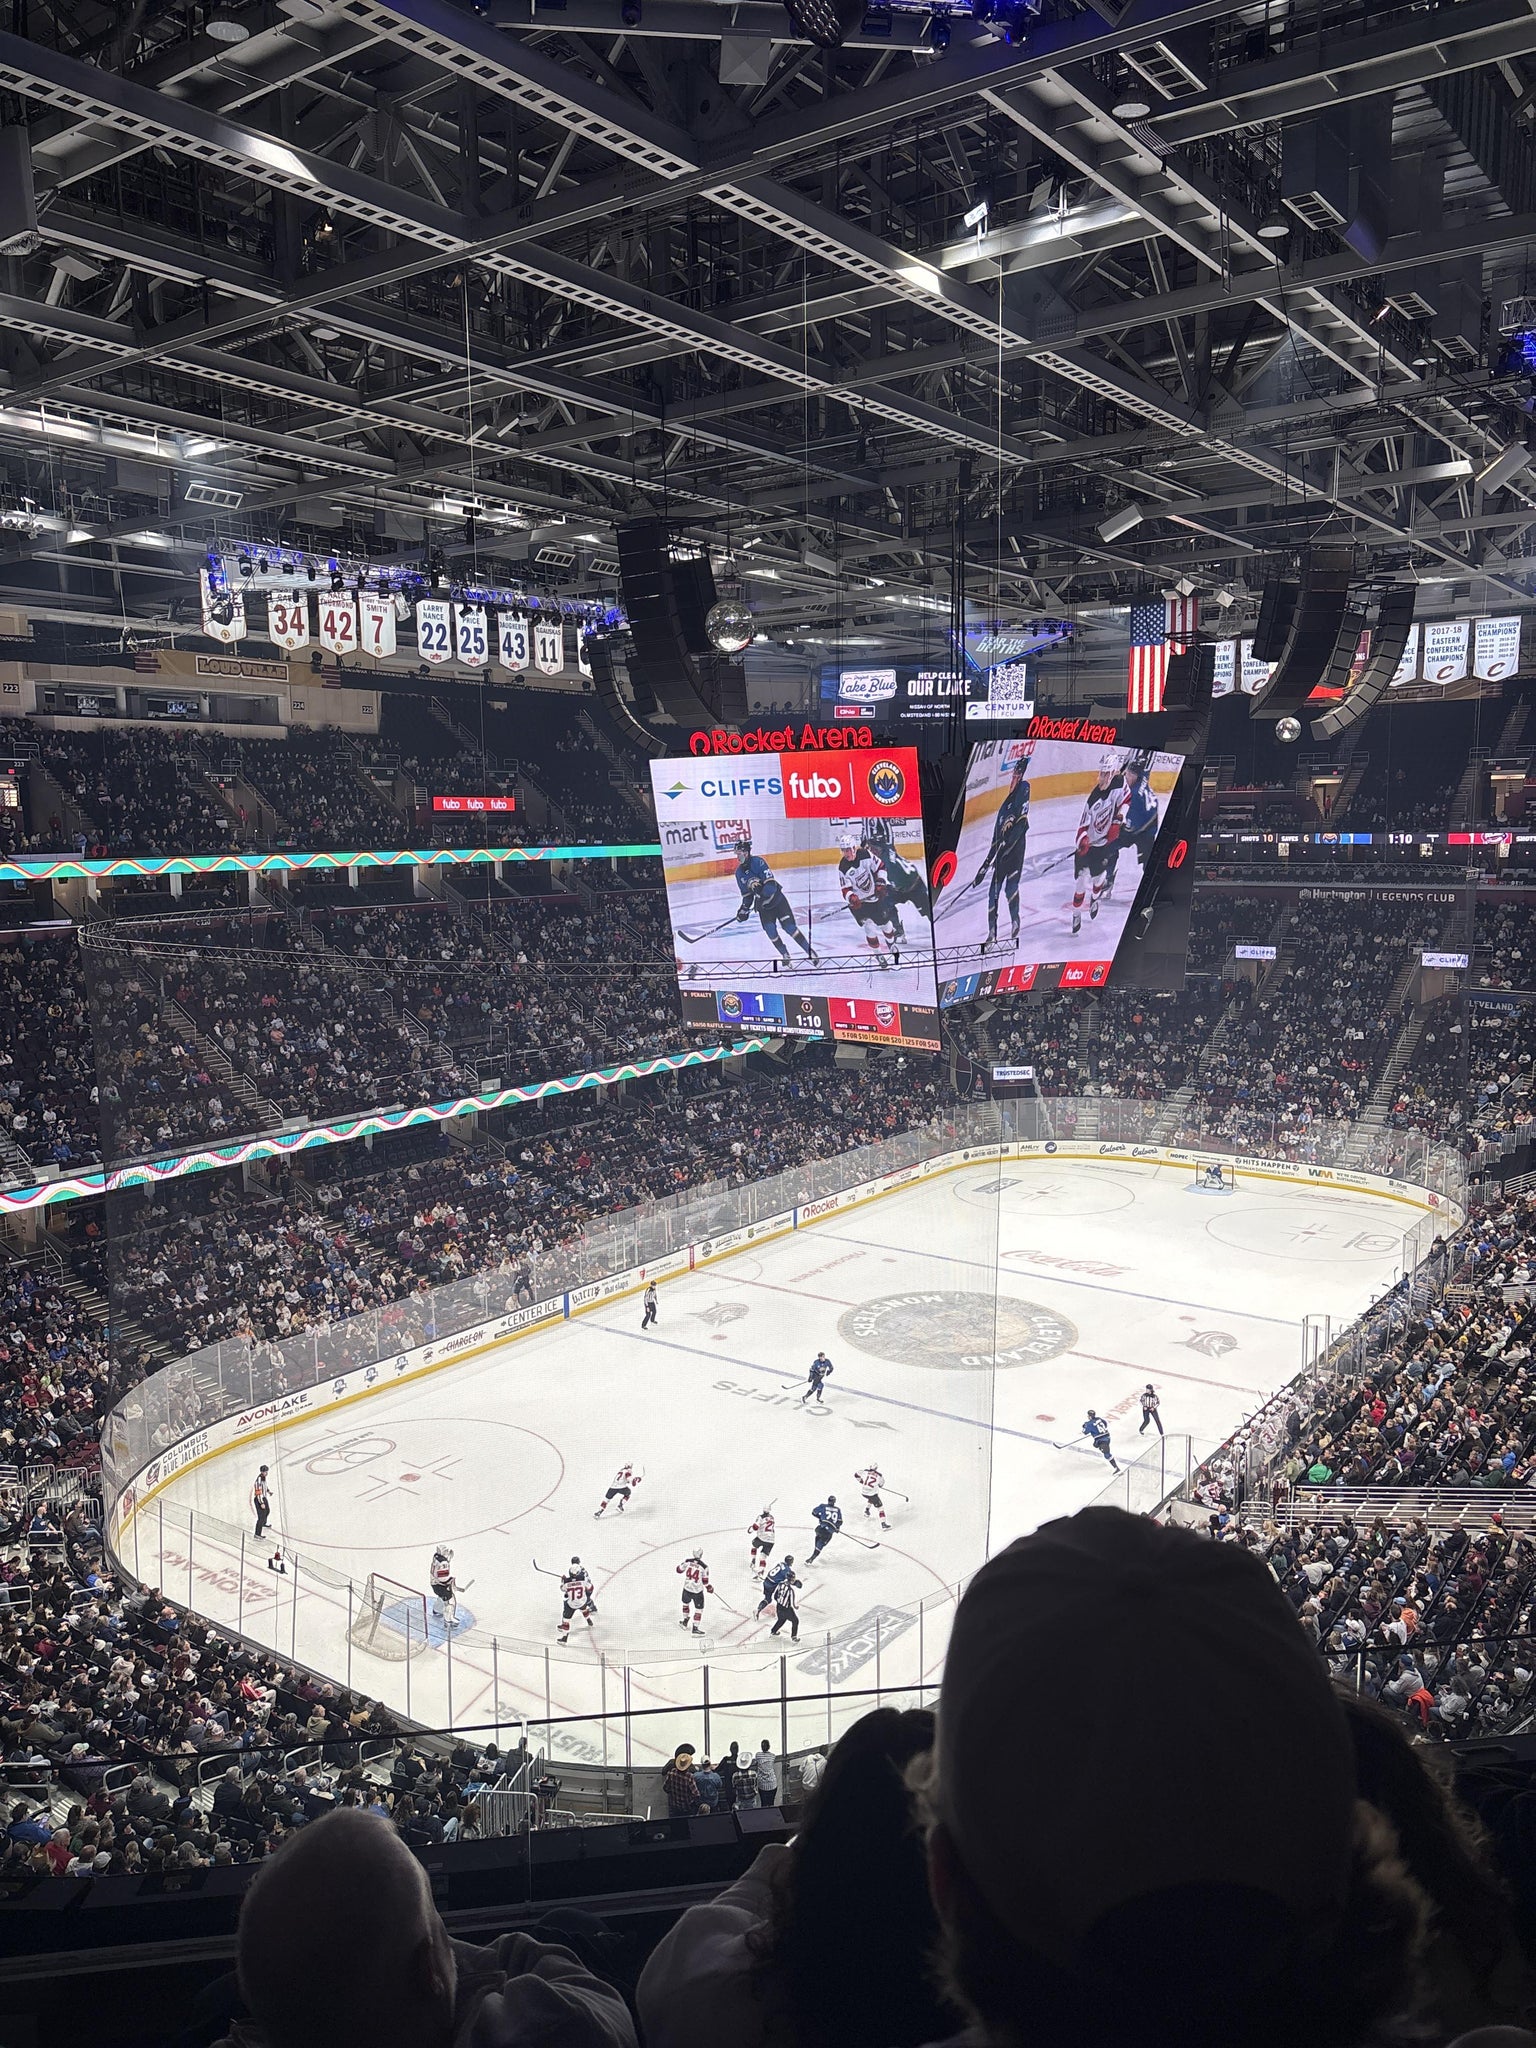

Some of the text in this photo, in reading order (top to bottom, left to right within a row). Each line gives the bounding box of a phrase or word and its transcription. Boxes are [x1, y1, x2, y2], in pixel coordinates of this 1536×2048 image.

[366, 604, 387, 613] SMITH
[423, 604, 443, 613] LARRY
[274, 604, 305, 636] 34
[422, 612, 444, 621] NANCE
[462, 616, 480, 625] PRICE
[324, 610, 352, 641] 42
[371, 615, 384, 643] 7
[1431, 626, 1462, 635] 2017-18
[1478, 627, 1517, 637] CHAMPIONS
[421, 622, 447, 650] 22
[460, 626, 485, 655] 25
[982, 637, 1028, 646] FEAR THE
[1432, 637, 1460, 645] EASTERN
[502, 632, 525, 660] 43
[540, 637, 558, 663] 11
[976, 642, 1024, 655] DEPTHS
[1426, 645, 1465, 654] CONFERENCE
[1427, 654, 1463, 663] CHAMPIONS
[3, 684, 19, 693] 223
[839, 678, 896, 694] Lake Blue
[908, 680, 972, 696] OUR LAKE
[1038, 716, 1117, 744] Rocket Arena
[711, 723, 873, 755] Rocket Arena
[871, 760, 900, 775] CLEVELAND
[700, 777, 782, 797] CLIFFS
[788, 772, 842, 799] fubo
[442, 798, 507, 809] fubo fubo fubo
[665, 821, 709, 845] mart
[1263, 834, 1273, 843] 10
[1303, 834, 1310, 843] 6
[1388, 833, 1412, 844] 1:10
[1313, 889, 1455, 903] Huntington LEGENDS CLUB
[1007, 967, 1015, 983] 1
[1065, 969, 1084, 981] fubo
[964, 978, 971, 992] 1
[755, 994, 765, 1012] 1
[846, 1000, 856, 1019] 1
[796, 1015, 821, 1028] 1:10
[927, 1040, 939, 1048] $40
[1261, 1161, 1291, 1170] HAPPEN
[1308, 1168, 1334, 1180] WM
[810, 1197, 839, 1217] Rocket
[507, 1307, 543, 1327] CENTER
[544, 1299, 558, 1313] ICE
[852, 1294, 944, 1339] MONSTERS
[961, 1315, 1064, 1366] CLEVELAND
[237, 1393, 308, 1427] AVONLAKE
[163, 1432, 208, 1463] COLUMBUS
[163, 1441, 209, 1476] BLUE JACKETS
[617, 1471, 624, 1481] 7
[864, 1476, 877, 1488] 12
[685, 1567, 700, 1581] 44
[567, 1586, 583, 1599] 73
